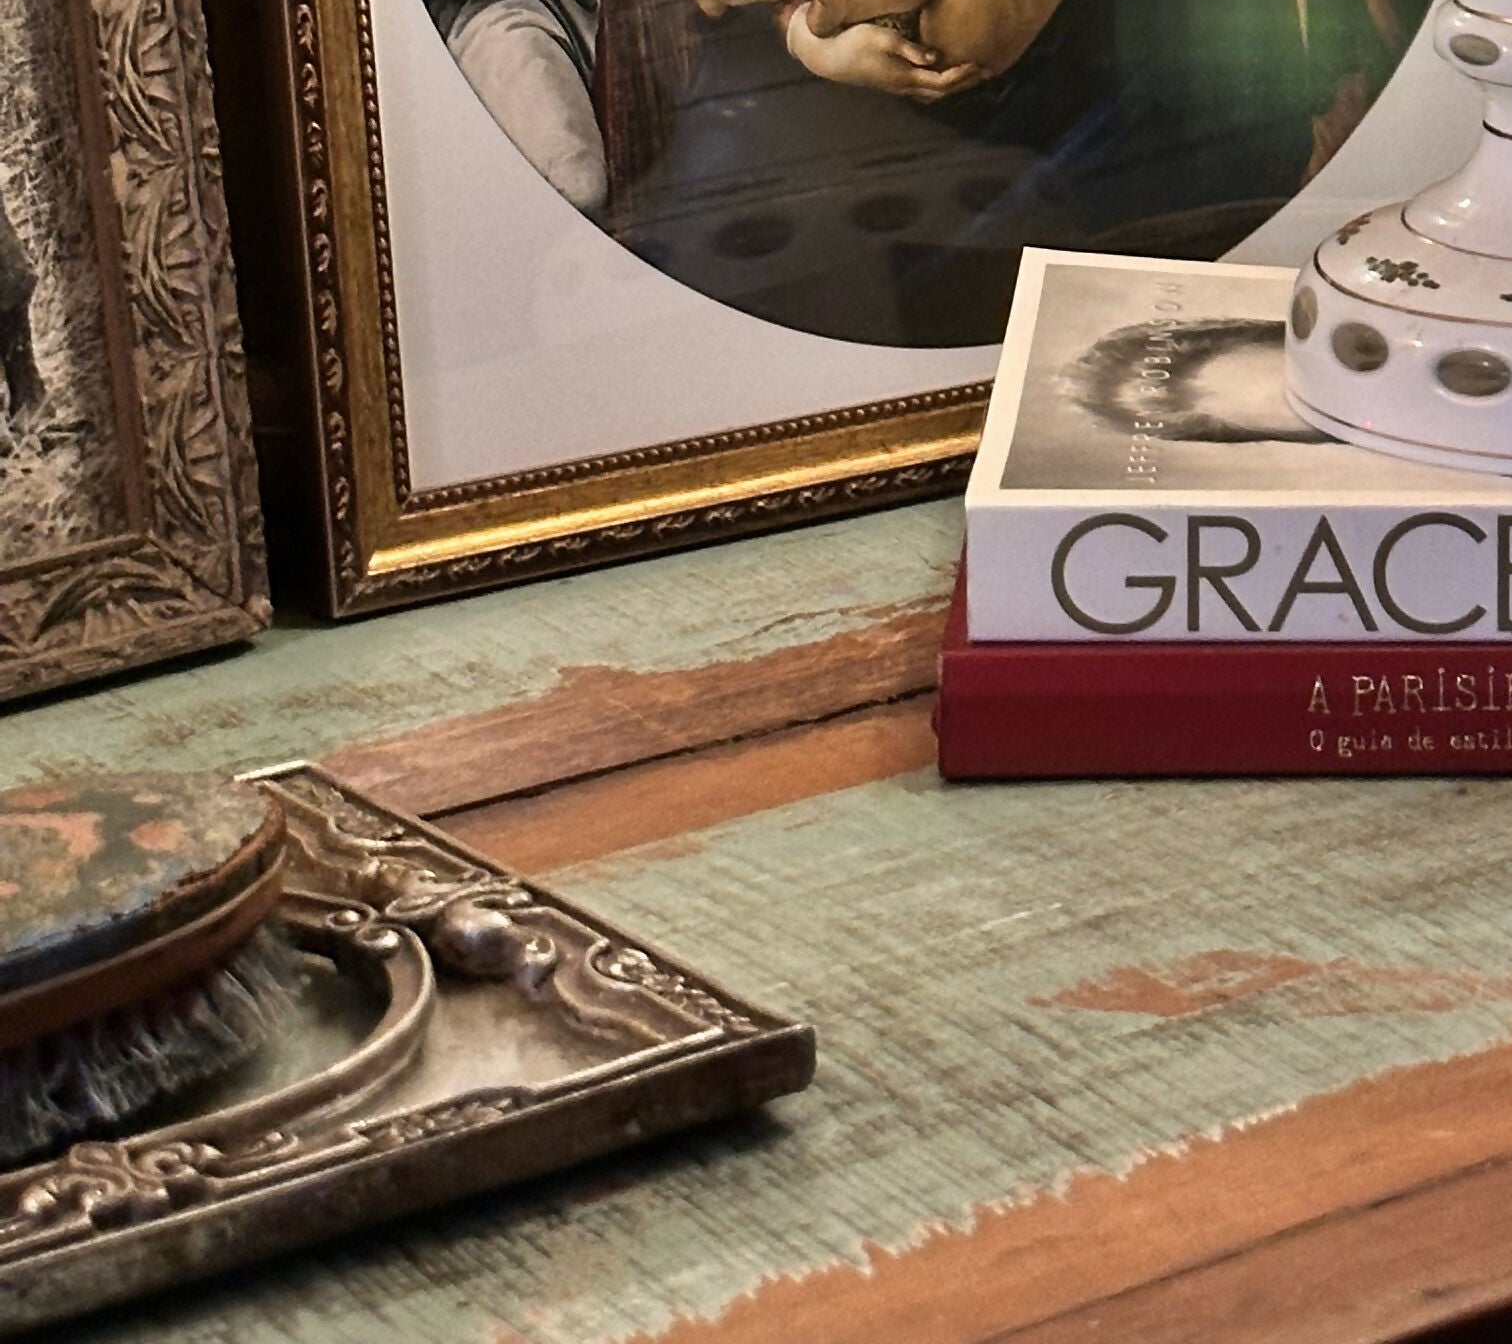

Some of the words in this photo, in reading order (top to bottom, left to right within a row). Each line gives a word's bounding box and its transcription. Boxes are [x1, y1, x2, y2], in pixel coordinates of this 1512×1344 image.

[1308, 674, 1331, 714] A
[1309, 728, 1324, 752] O
[1338, 728, 1393, 758] guia
[1408, 726, 1435, 751] de
